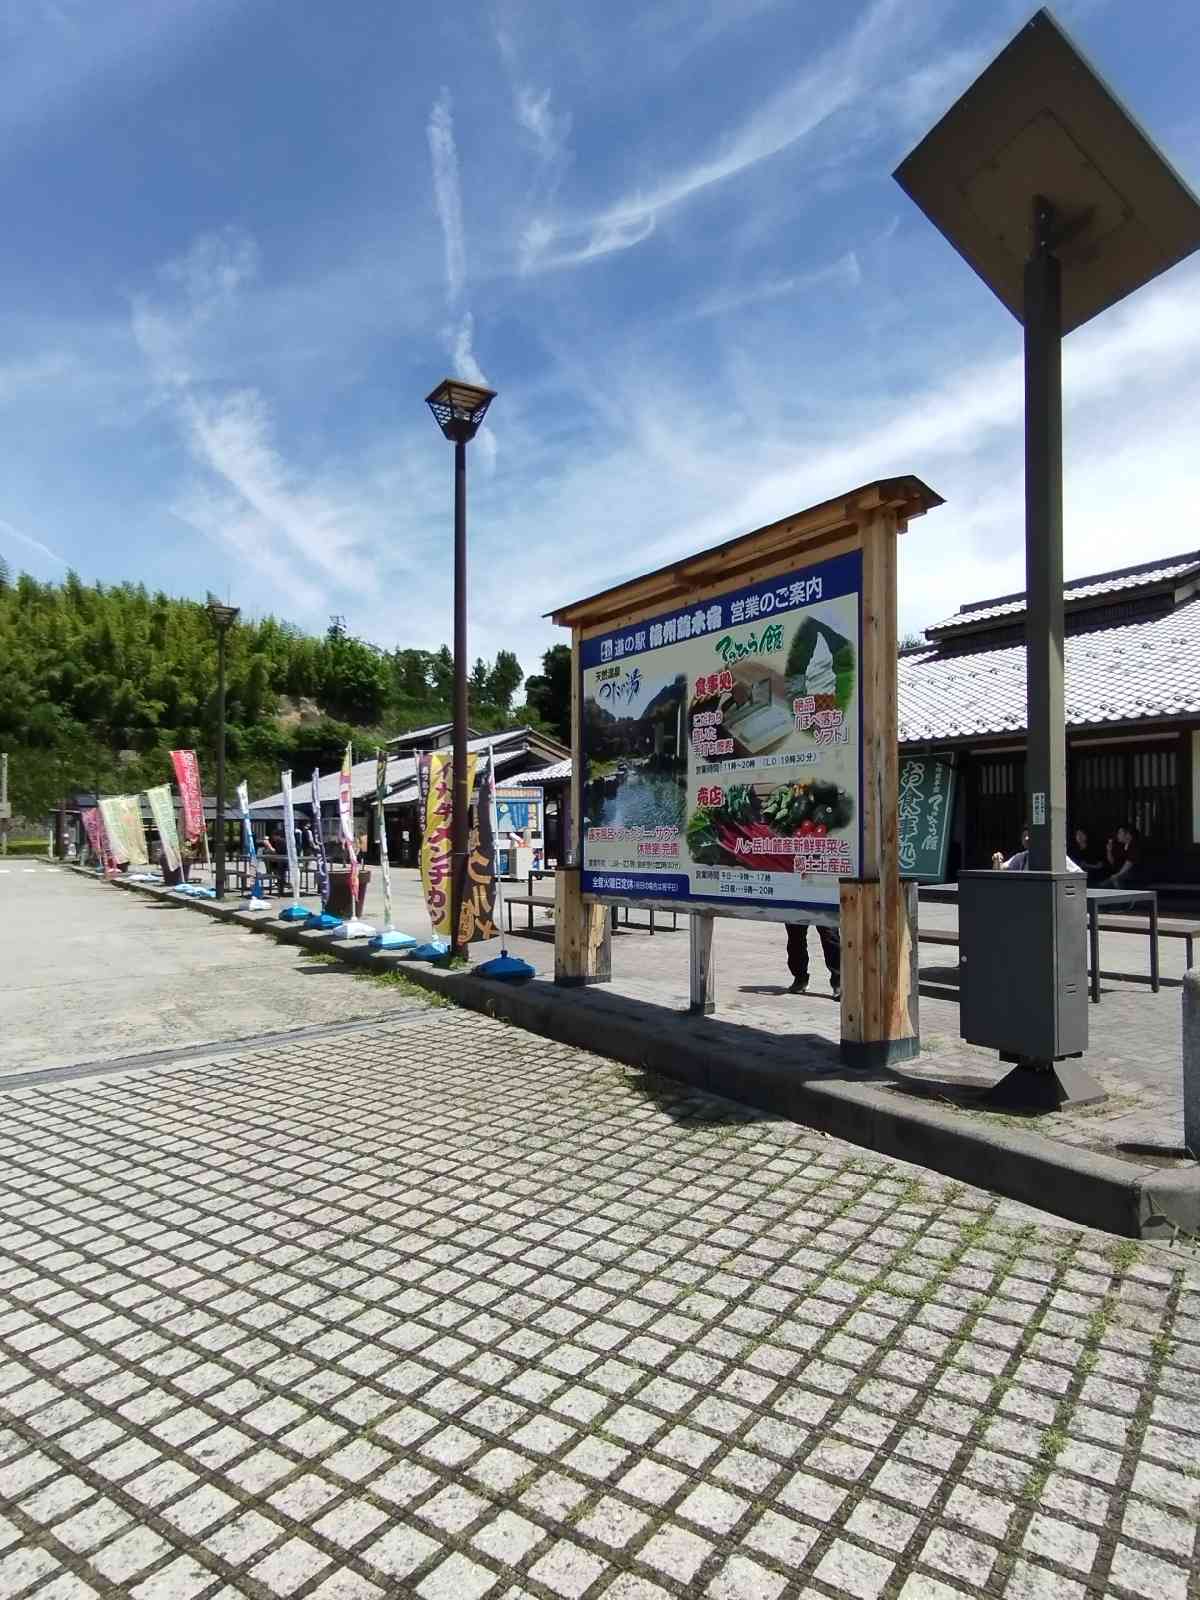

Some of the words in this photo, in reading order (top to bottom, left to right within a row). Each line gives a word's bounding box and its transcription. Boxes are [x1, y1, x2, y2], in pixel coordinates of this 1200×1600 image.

[730, 576, 823, 624] 営業のご案内
